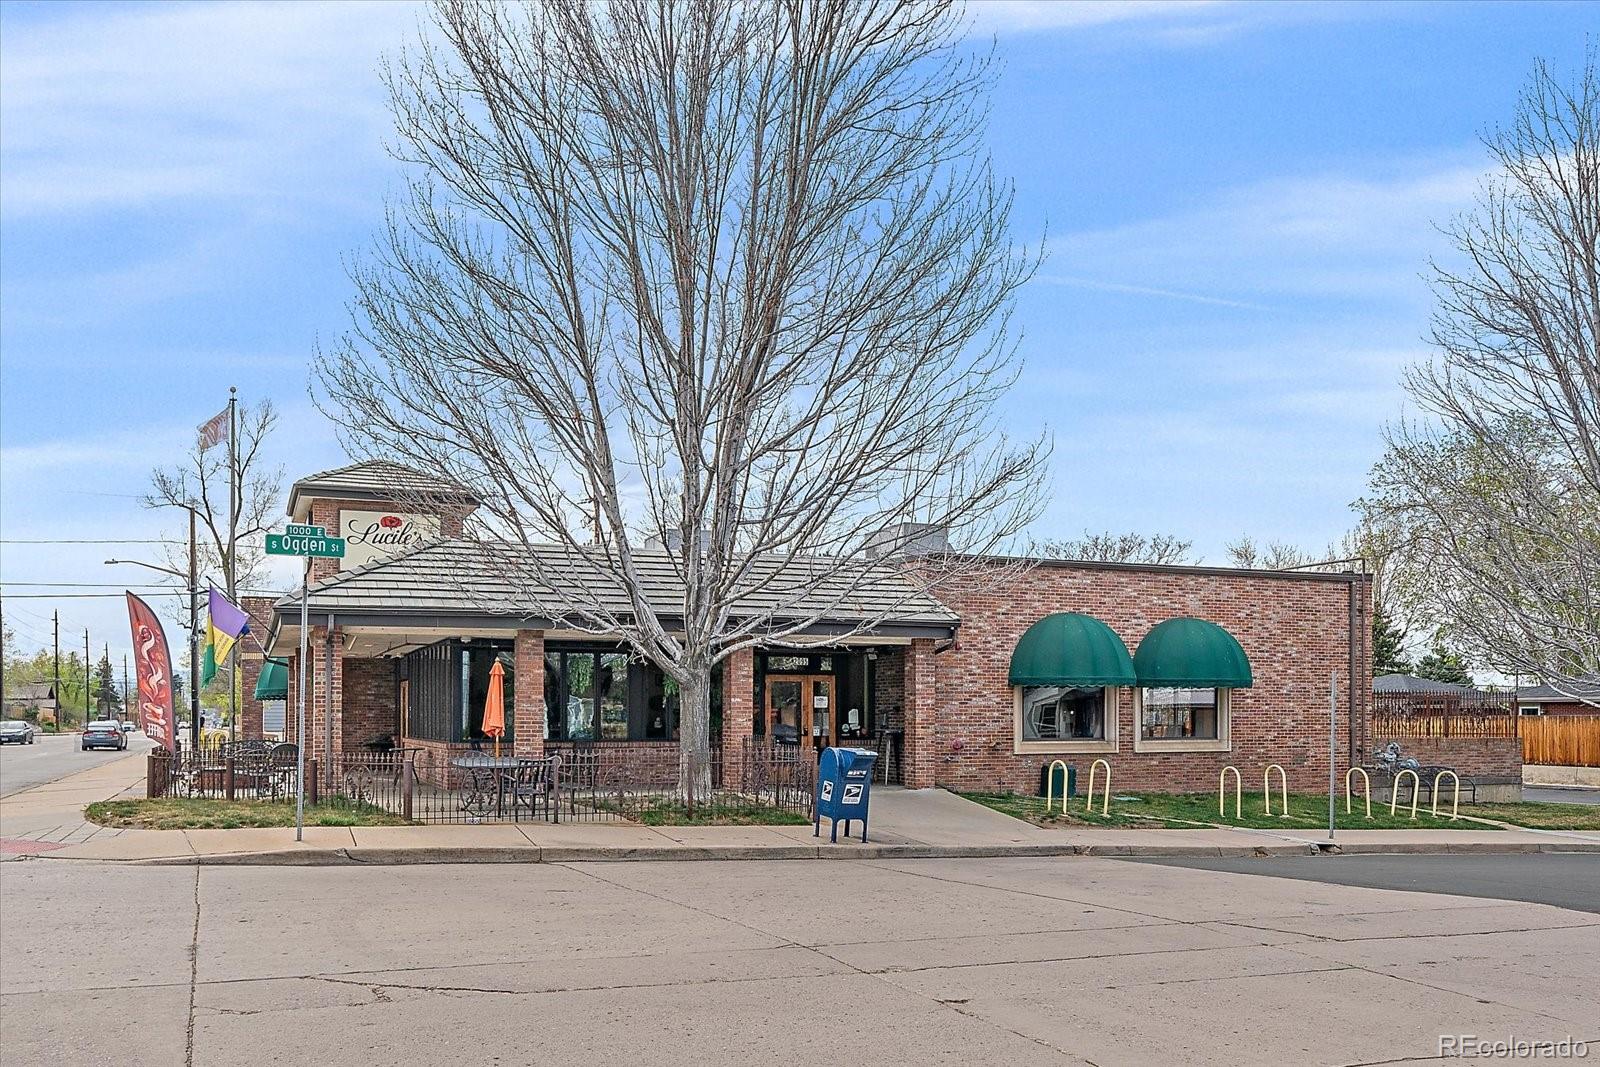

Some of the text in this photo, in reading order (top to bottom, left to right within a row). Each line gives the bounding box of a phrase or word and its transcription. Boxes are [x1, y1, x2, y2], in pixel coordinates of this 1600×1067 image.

[289, 526, 323, 536] 1000 E
[347, 519, 423, 549] Lucile's
[271, 535, 339, 555] S Ogden St
